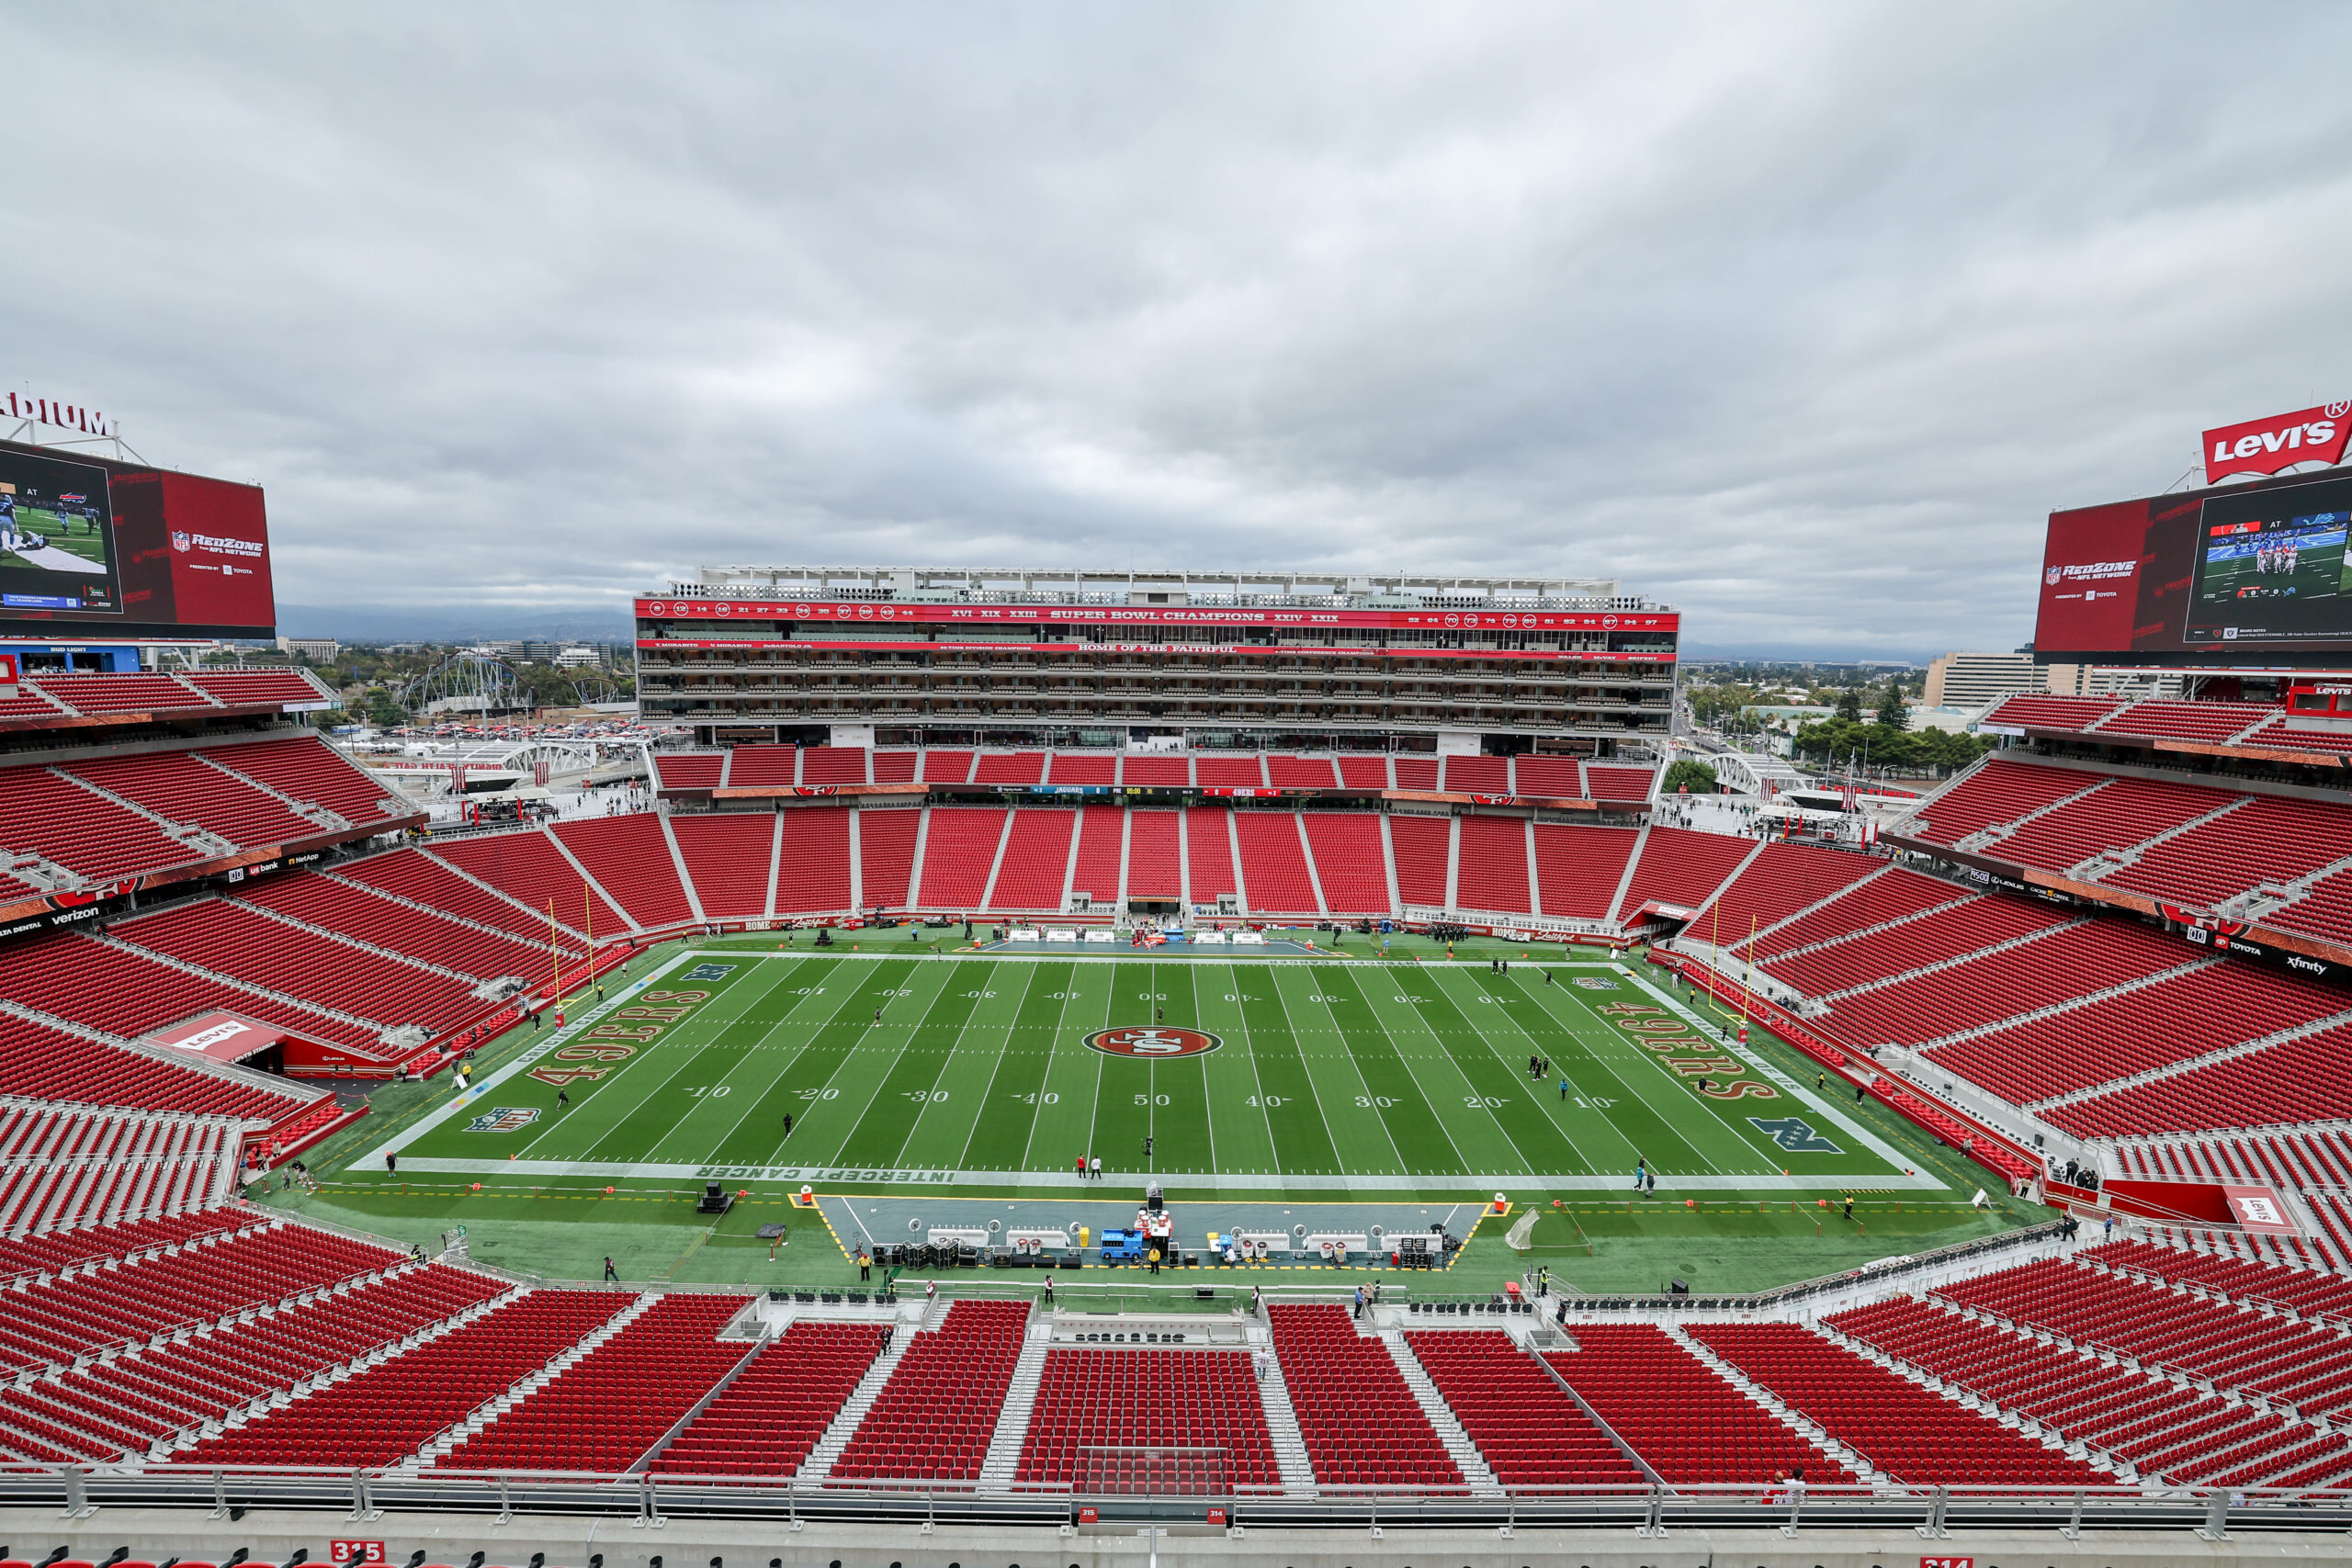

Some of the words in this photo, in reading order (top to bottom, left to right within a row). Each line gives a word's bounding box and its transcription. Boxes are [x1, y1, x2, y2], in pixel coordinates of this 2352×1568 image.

[2213, 420, 2335, 462] Levi's
[225, 548, 262, 558] NETWORK
[2092, 570, 2132, 580] NETWORK
[1050, 610, 1105, 619] SUPER
[1110, 611, 1159, 620] BOWL
[1163, 612, 1265, 621] CHAMPIONS
[1172, 645, 1238, 653] FAITHFUL
[1232, 788, 1255, 796] 49ERS
[295, 853, 319, 863] NetApp
[250, 866, 259, 874] us
[260, 862, 278, 872] bank
[1999, 879, 2024, 890] LEXUS
[2030, 886, 2047, 896] CACHE
[2053, 893, 2070, 902] CREEK
[51, 907, 99, 925] verizon
[13, 922, 41, 933] DENTAL
[745, 921, 771, 931] HOME
[1535, 931, 1575, 943] Faithful
[2230, 942, 2261, 955] TOYOTA
[2287, 956, 2327, 976] xfinity
[967, 990, 997, 998] 30
[1053, 991, 1081, 999] 40
[1225, 993, 1255, 1001] 40
[1309, 994, 1340, 1002] 30
[1394, 995, 1424, 1004] 20
[1477, 996, 1509, 1005] 10
[187, 1022, 240, 1047] Levi's
[516, 1028, 576, 1063] CRUCIAL
[575, 1003, 617, 1025] CATCH
[525, 989, 712, 1087] 49ERS
[252, 1041, 277, 1057] STADIUM
[1595, 1000, 1785, 1100] 49ERS
[1755, 1063, 1777, 1075] OF
[1777, 1077, 1802, 1090] US
[691, 1086, 731, 1099] 10
[799, 1088, 840, 1100] 20
[910, 1090, 949, 1102] 30
[1022, 1092, 1059, 1104] 40
[1134, 1094, 1170, 1106] 50
[1245, 1095, 1283, 1108] 40
[1354, 1096, 1393, 1108] 30
[1464, 1096, 1502, 1109] 20
[1573, 1096, 1611, 1109] 10
[695, 1167, 800, 1179] CANCER
[811, 1171, 956, 1183] INTERCEPT
[2249, 1199, 2272, 1222] Levi's
